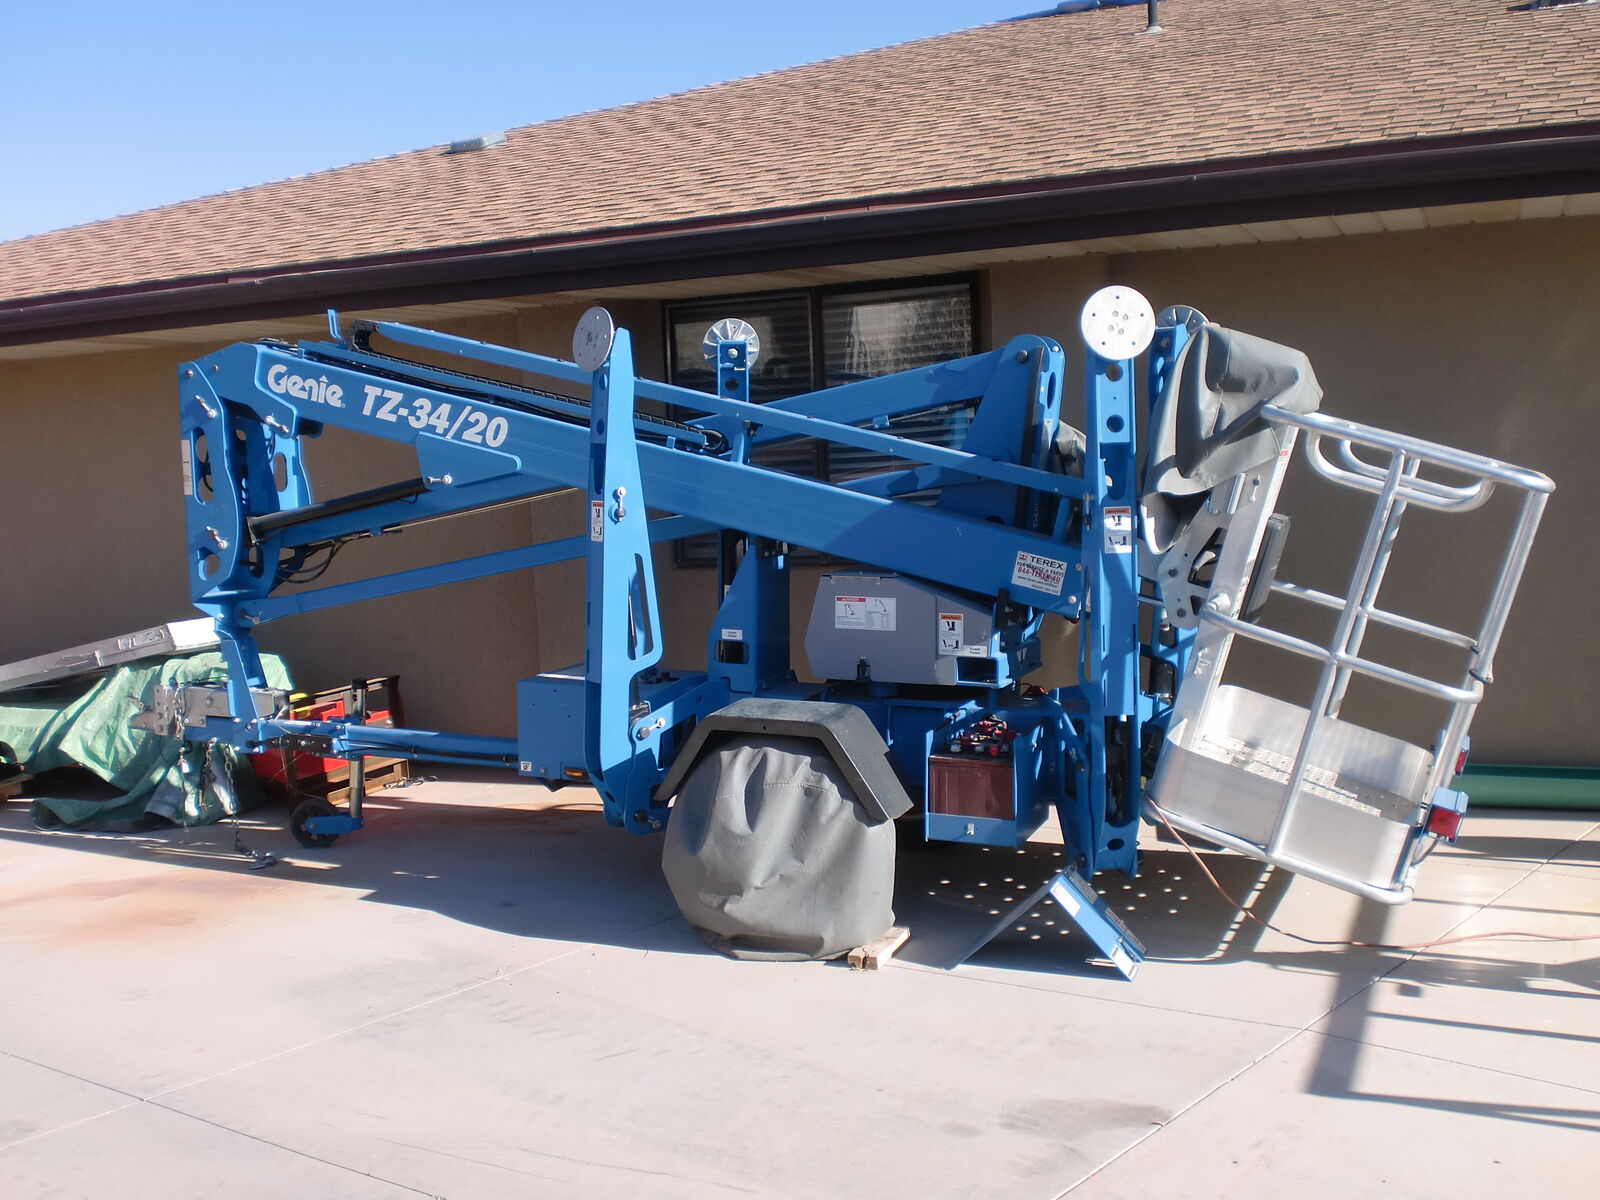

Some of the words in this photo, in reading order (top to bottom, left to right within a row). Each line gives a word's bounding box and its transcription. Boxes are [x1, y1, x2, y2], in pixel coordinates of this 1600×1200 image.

[267, 364, 343, 408] Genie
[361, 384, 509, 448] TZ-34/20
[1030, 555, 1064, 570] TEREX
